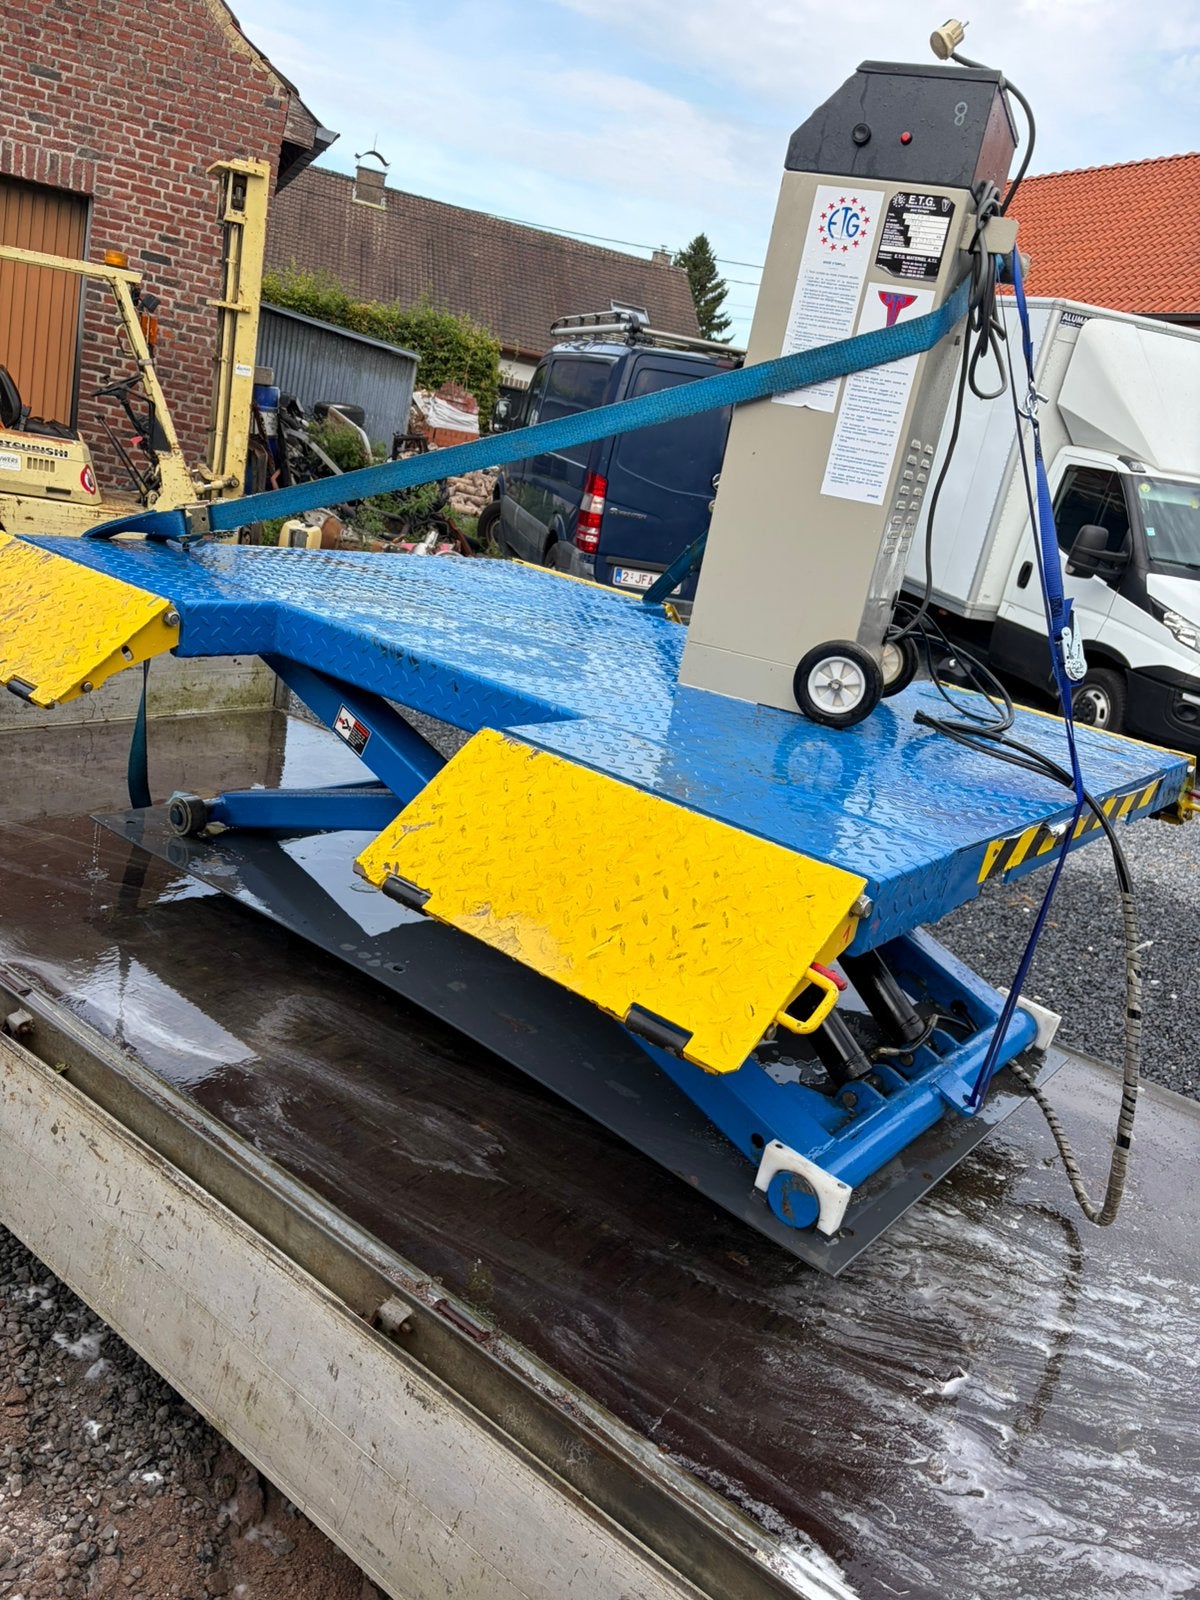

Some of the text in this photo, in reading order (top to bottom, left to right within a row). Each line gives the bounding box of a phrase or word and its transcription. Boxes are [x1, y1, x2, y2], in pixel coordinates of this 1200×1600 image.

[954, 101, 968, 126] 8
[908, 194, 936, 207] E.T.G.
[827, 206, 860, 240] ETG
